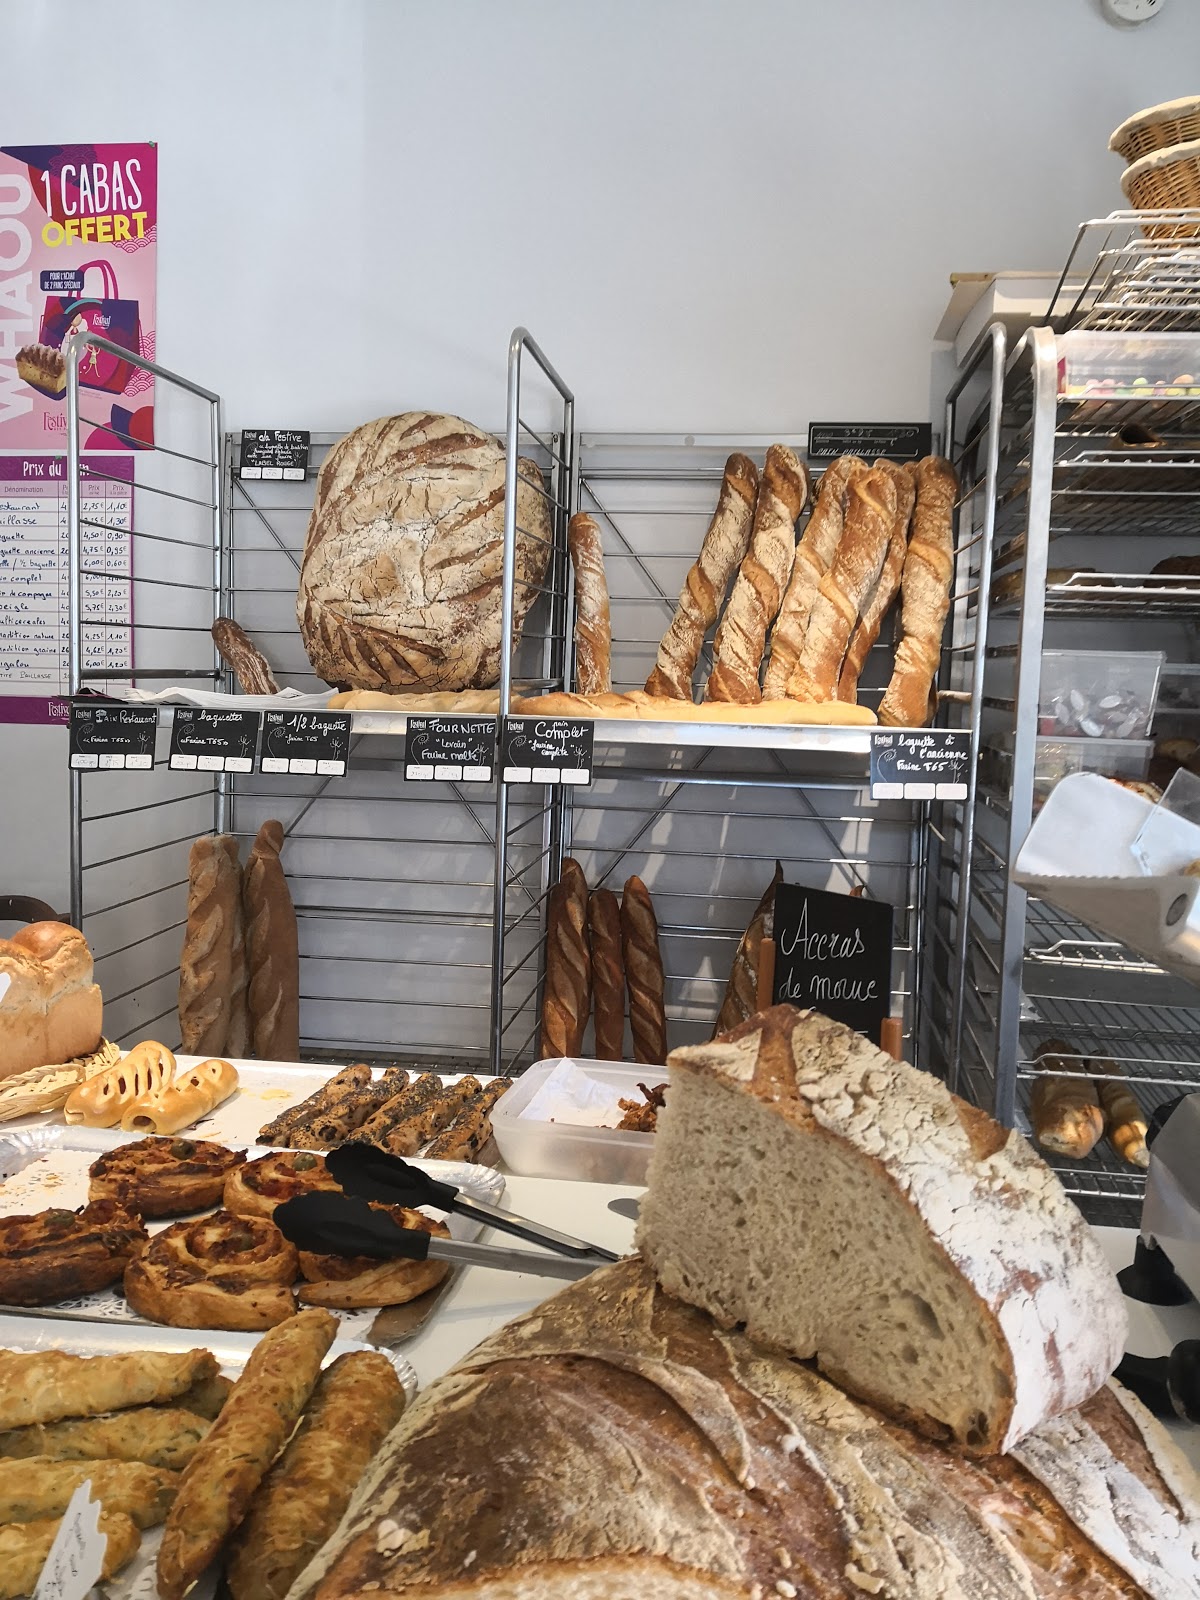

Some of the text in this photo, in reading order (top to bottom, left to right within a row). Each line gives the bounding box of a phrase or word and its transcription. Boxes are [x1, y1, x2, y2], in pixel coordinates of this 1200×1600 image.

[41, 159, 142, 217] 1 CABAS
[41, 211, 147, 248] OFFERT
[0, 173, 33, 422] WHAOU
[43, 411, 67, 431] Festiv
[274, 430, 302, 443] Festive
[23, 461, 44, 476] Prix
[48, 460, 62, 476] du
[4, 484, 44, 493] Dénomination
[29, 559, 56, 570] baguette
[10, 573, 42, 587] complet
[0, 602, 29, 613] eigle
[0, 659, 30, 671] igalou
[119, 709, 157, 724] Restaurant
[286, 714, 307, 732] 1/2
[309, 716, 347, 737] baguette
[428, 718, 495, 734] FOURNETTE
[535, 721, 589, 749] Complet
[780, 897, 865, 961] Accras
[779, 967, 802, 1001] de
